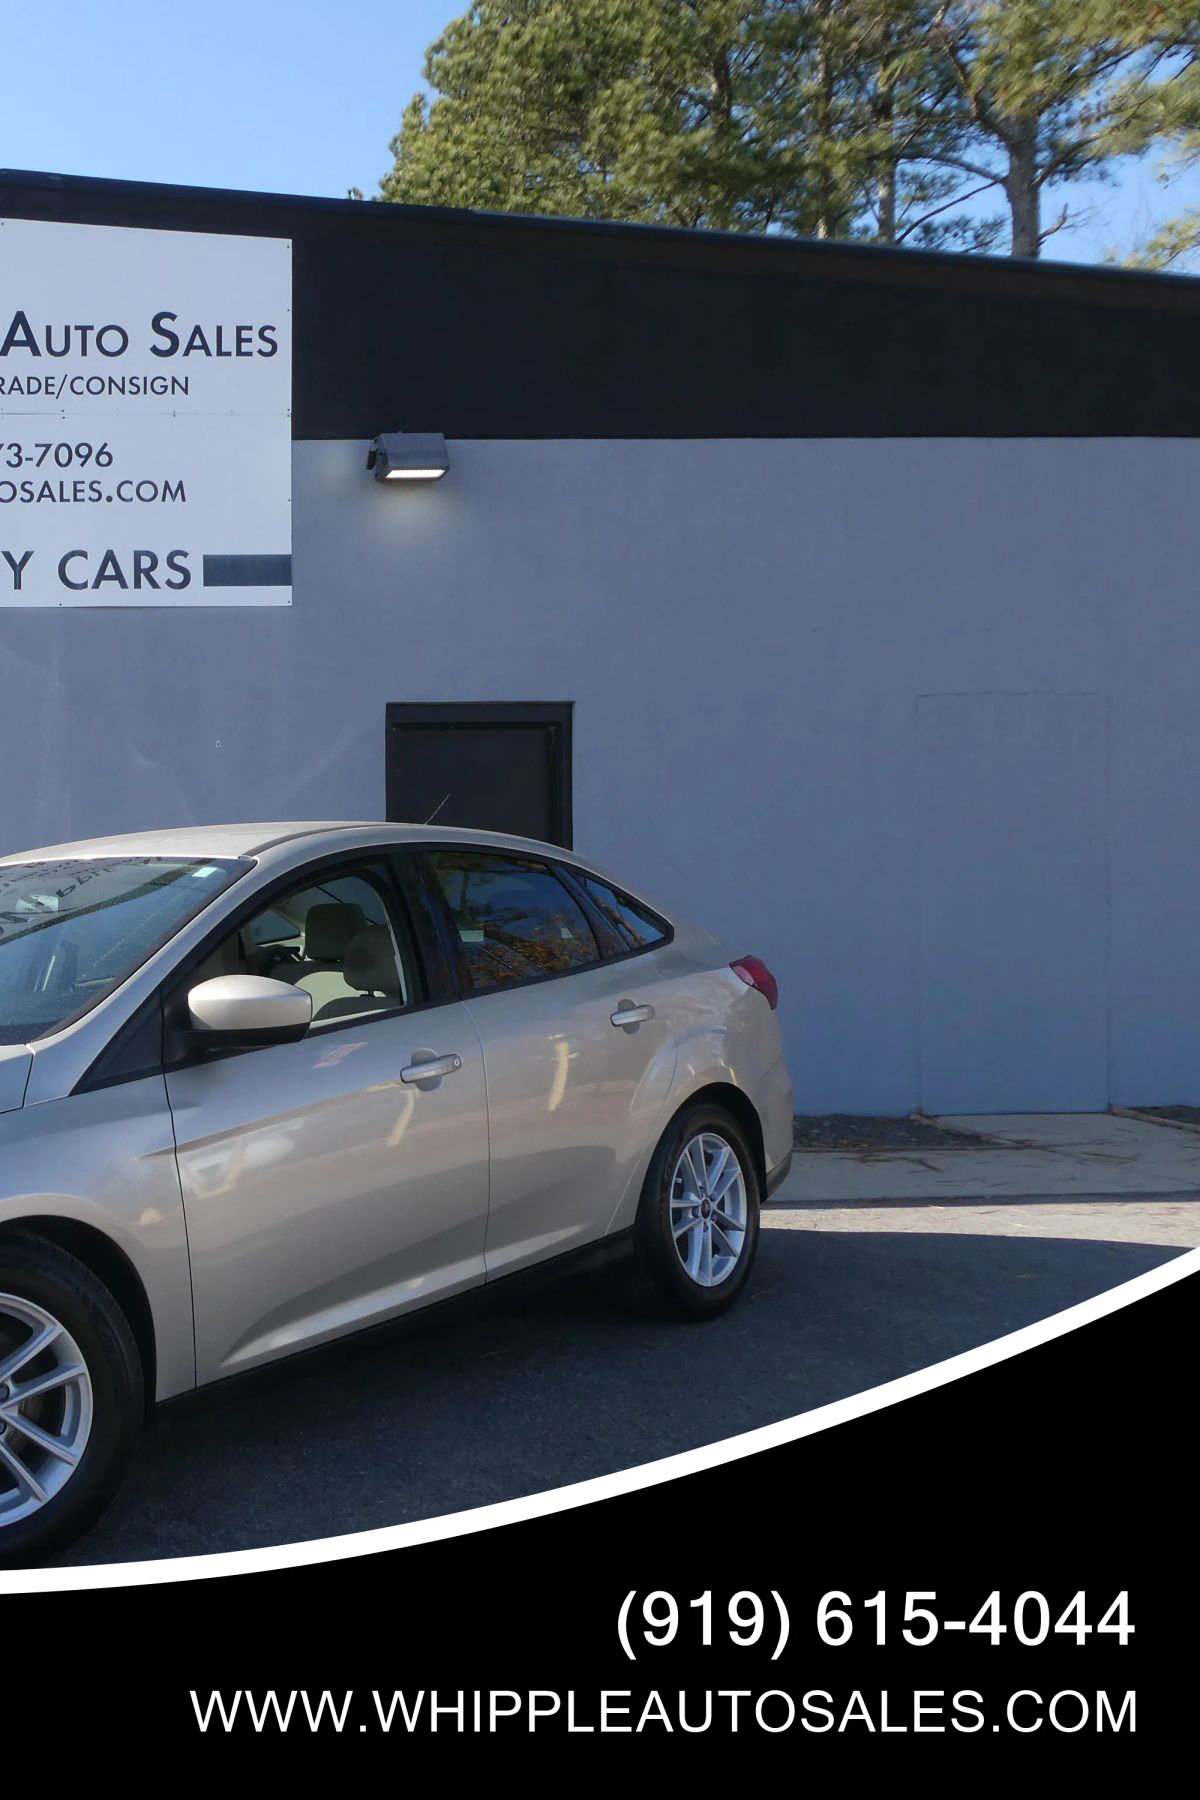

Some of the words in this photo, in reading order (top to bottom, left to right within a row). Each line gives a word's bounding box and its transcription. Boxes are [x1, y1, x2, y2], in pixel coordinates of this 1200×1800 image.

[0, 311, 128, 357] AUTO
[150, 311, 278, 357] SALES
[58, 550, 191, 590] CARS
